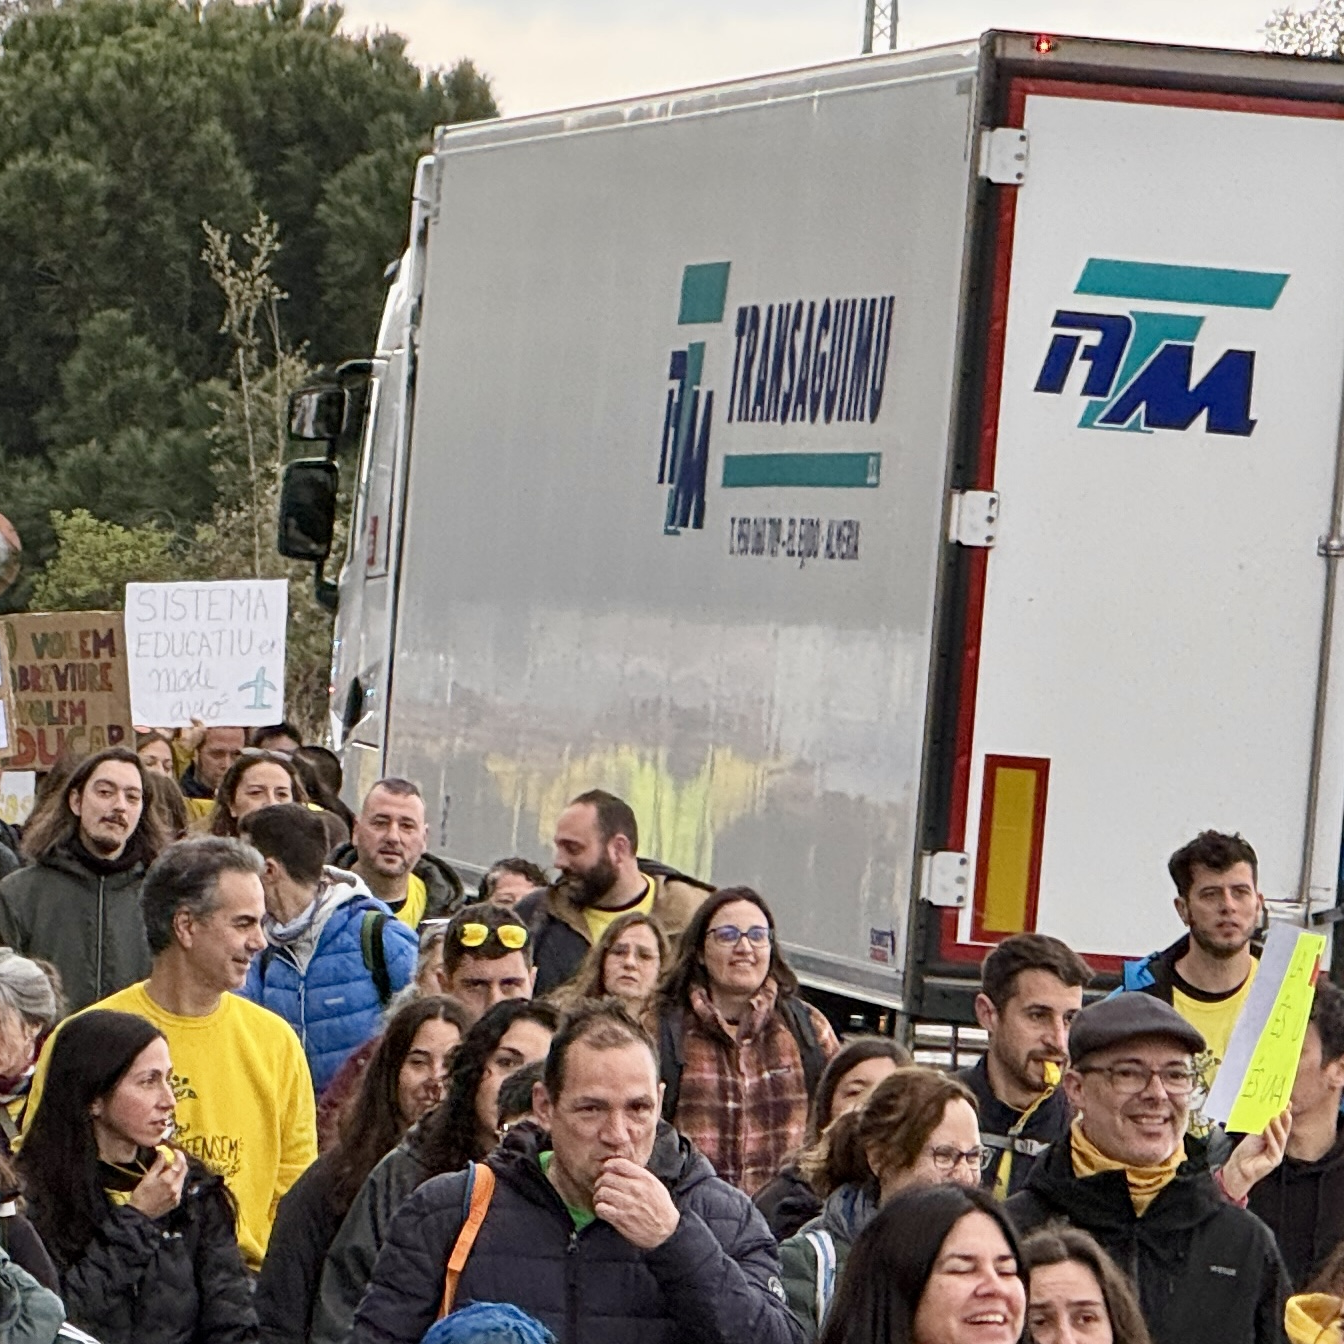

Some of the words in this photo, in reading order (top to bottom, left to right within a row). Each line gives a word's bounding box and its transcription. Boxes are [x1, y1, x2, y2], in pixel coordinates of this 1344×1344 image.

[728, 295, 895, 424] TRANSAGUIMU
[136, 588, 268, 622] SISTEMA
[31, 628, 116, 659] VOLEM
[136, 629, 253, 658] EDUCATIU
